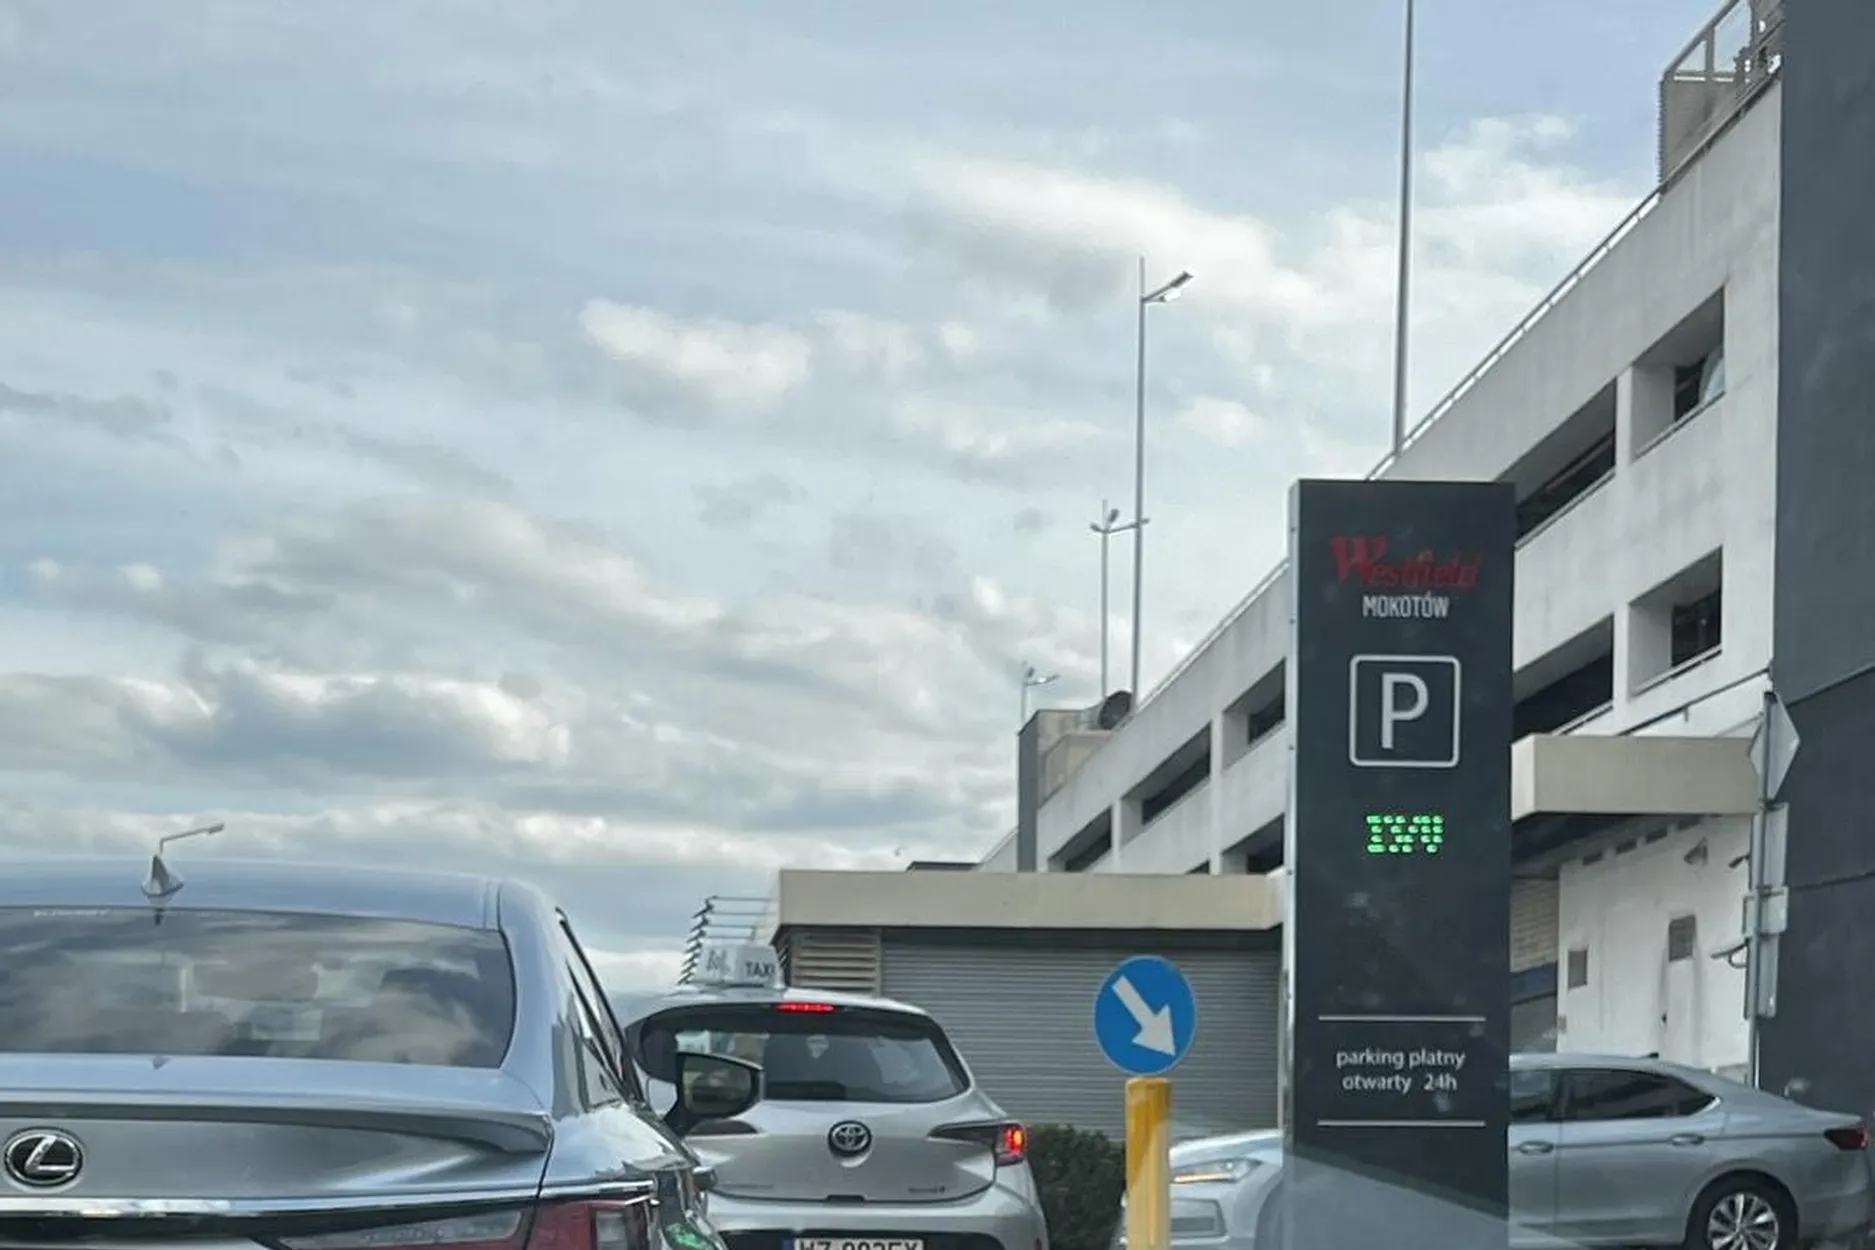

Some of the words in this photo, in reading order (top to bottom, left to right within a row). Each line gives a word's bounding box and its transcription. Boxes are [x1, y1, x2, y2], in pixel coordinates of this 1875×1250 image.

[1330, 533, 1483, 588] Westfield
[1362, 590, 1449, 618] MOKOTÓW
[1381, 673, 1429, 749] P
[1336, 1049, 1404, 1069] parking
[1342, 1074, 1412, 1094] otwarty
[1423, 1073, 1457, 1090] 24h
